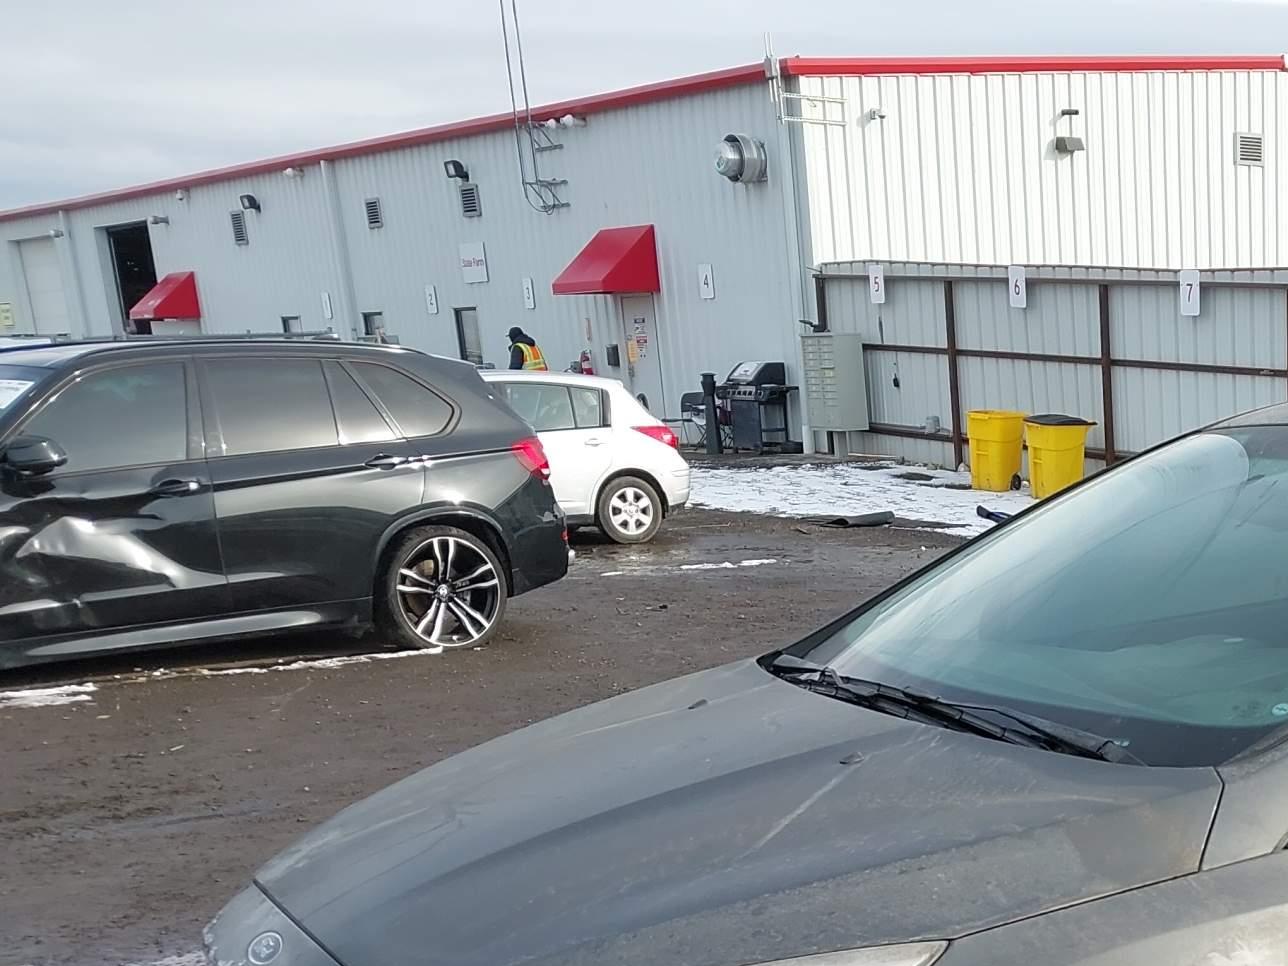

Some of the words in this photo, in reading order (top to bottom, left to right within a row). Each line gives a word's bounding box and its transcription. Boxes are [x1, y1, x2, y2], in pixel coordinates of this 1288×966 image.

[703, 274, 709, 288] 4
[873, 276, 880, 293] 5
[1014, 279, 1021, 296] 6
[1186, 283, 1193, 303] 7
